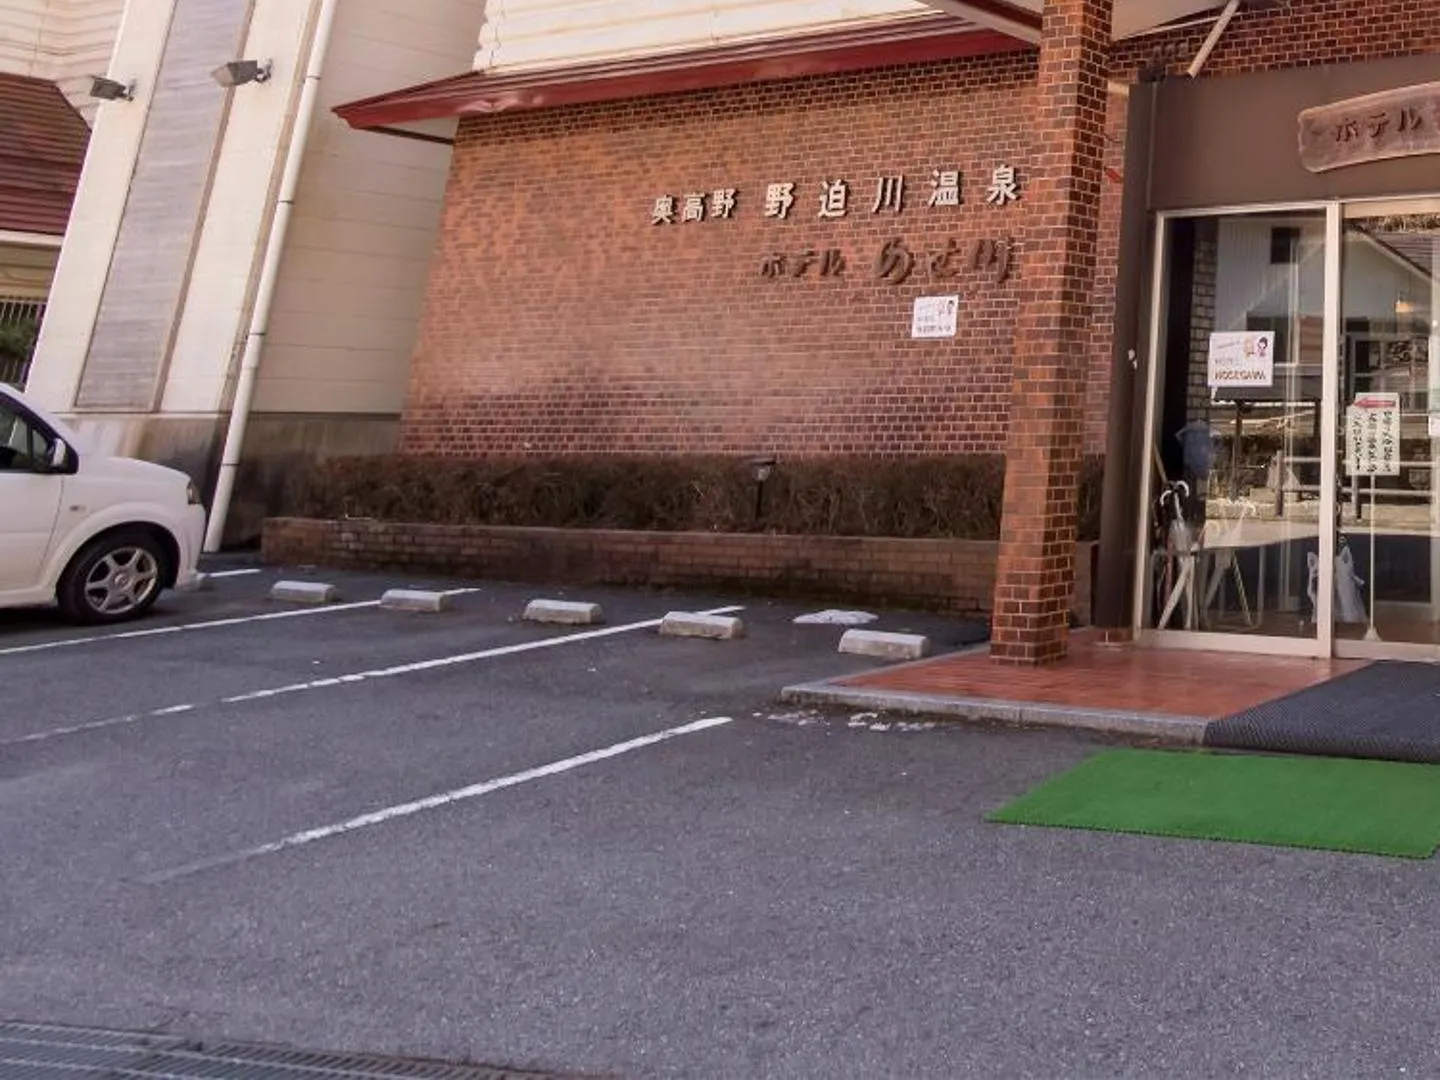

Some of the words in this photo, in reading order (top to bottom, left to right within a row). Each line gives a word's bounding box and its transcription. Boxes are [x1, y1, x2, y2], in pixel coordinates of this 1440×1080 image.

[651, 187, 738, 225] 奥高野
[764, 163, 1022, 219] 野迫川温泉
